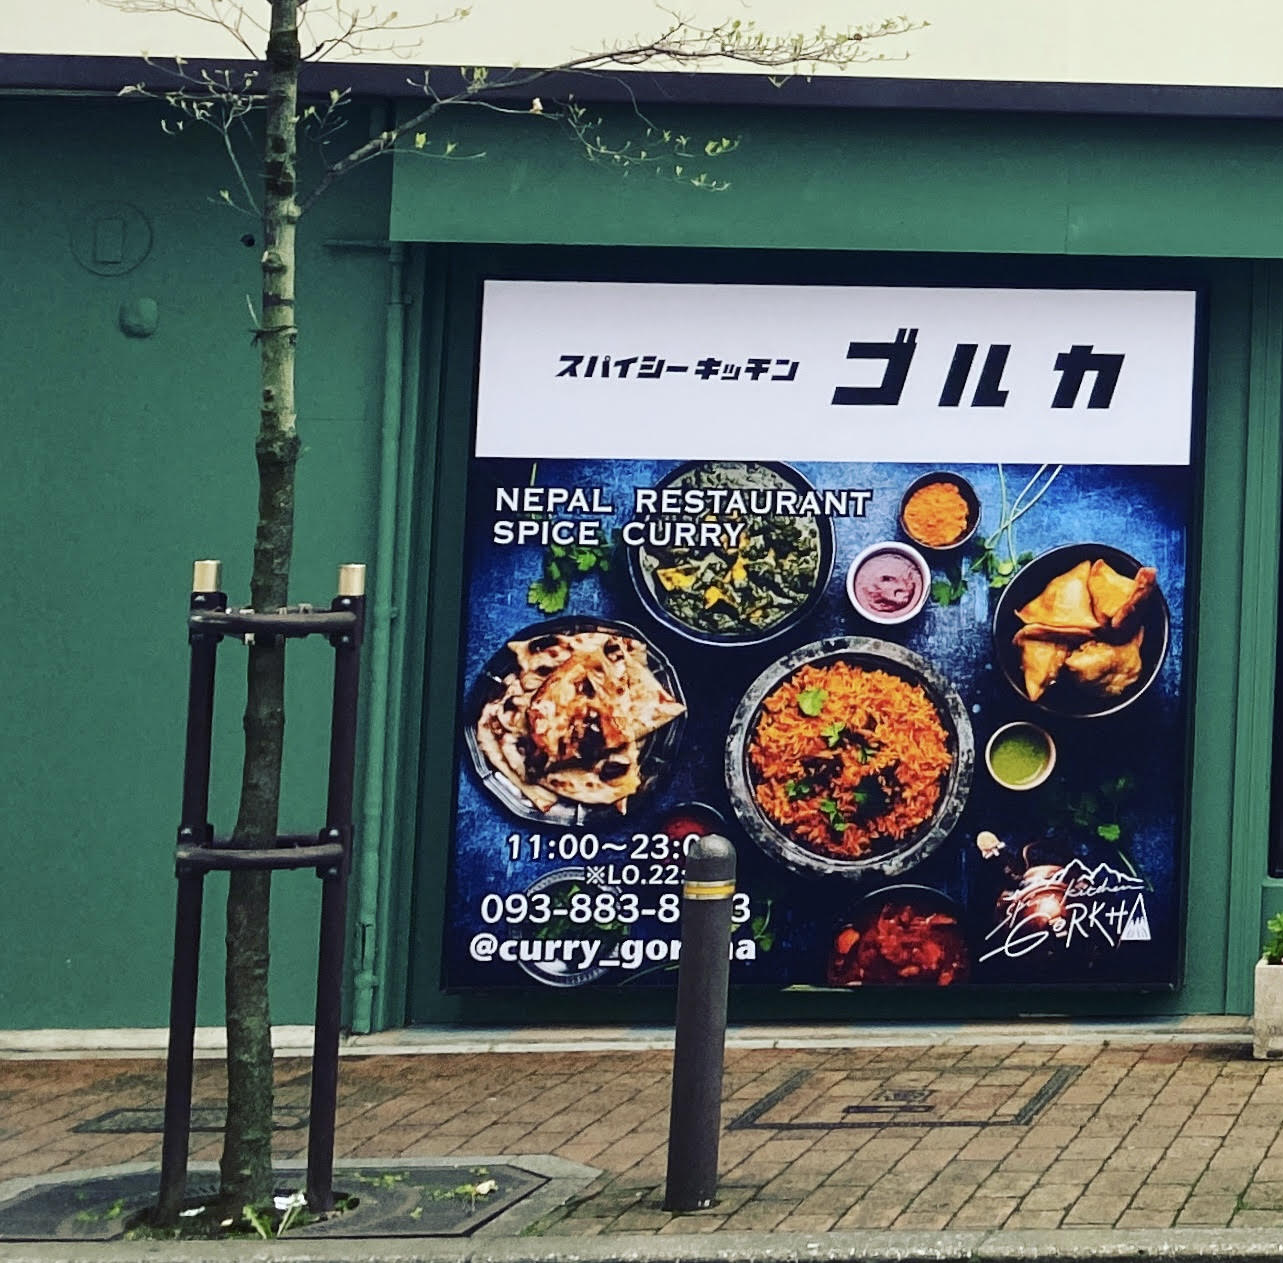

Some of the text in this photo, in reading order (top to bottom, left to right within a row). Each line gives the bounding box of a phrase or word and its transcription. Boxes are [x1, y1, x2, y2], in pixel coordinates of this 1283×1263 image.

[831, 328, 1126, 409] ゴルカ
[494, 486, 873, 517] NEPAL RESTAURANT
[492, 519, 747, 548] SPICE CURRY
[480, 893, 751, 925] 093-883-83
